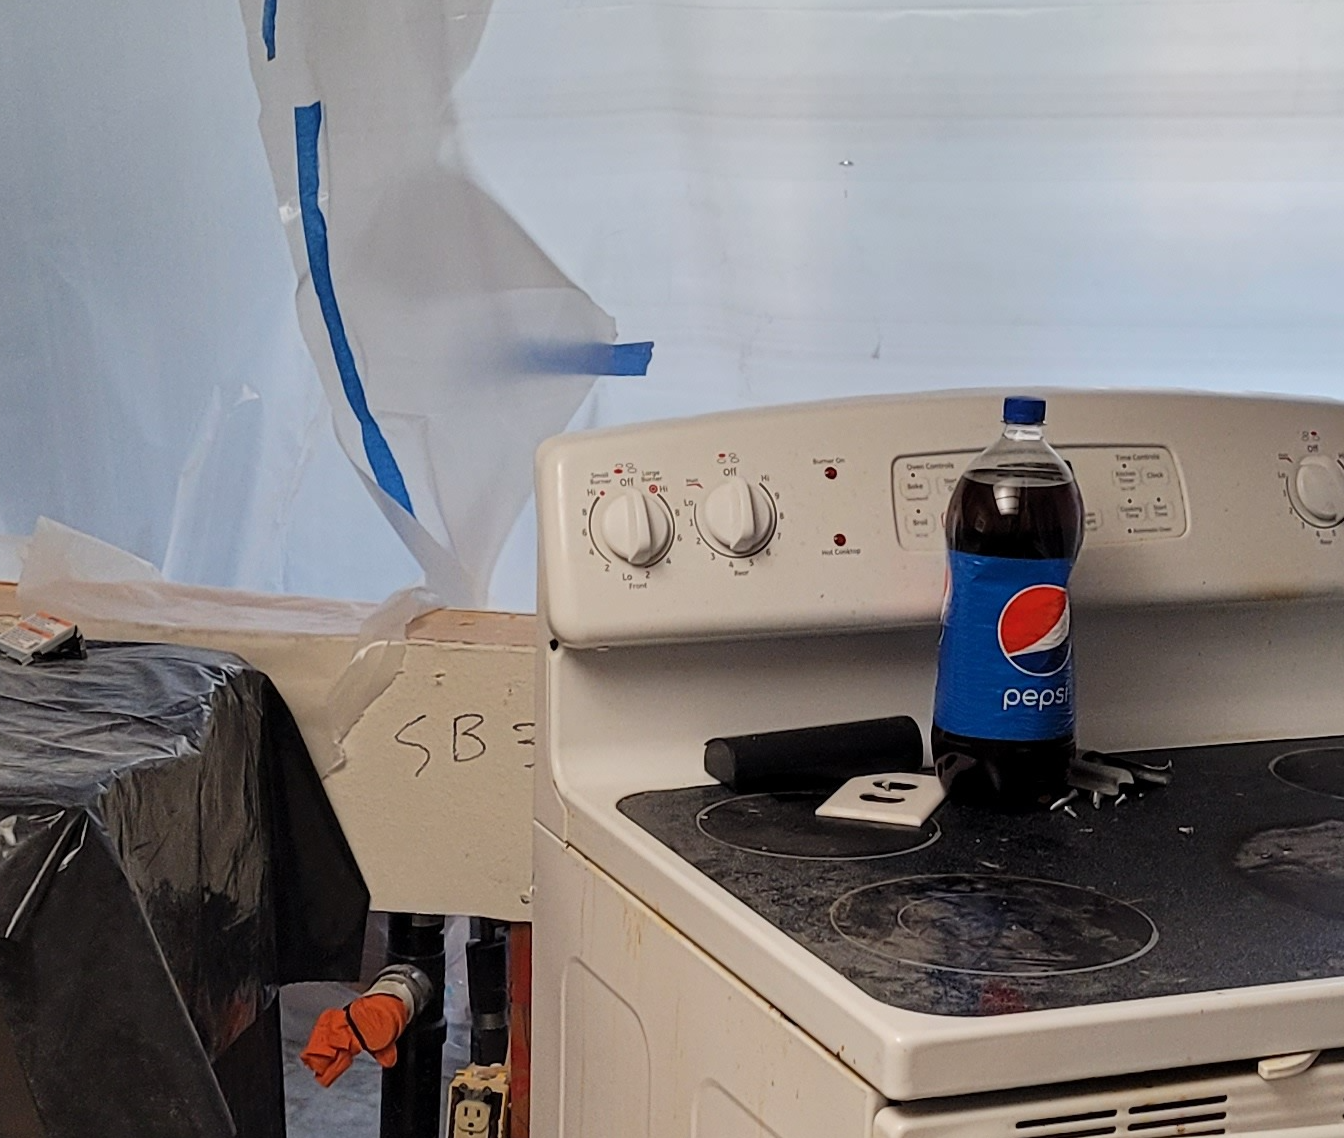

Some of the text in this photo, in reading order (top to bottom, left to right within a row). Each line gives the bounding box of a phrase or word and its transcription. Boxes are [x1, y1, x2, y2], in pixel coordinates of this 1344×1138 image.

[906, 462, 954, 471] Oven Controls
[723, 467, 737, 476] Off
[620, 478, 634, 486] Off
[834, 548, 862, 556] Cooktop
[628, 582, 648, 590] Front
[1002, 686, 1069, 712] pepsi
